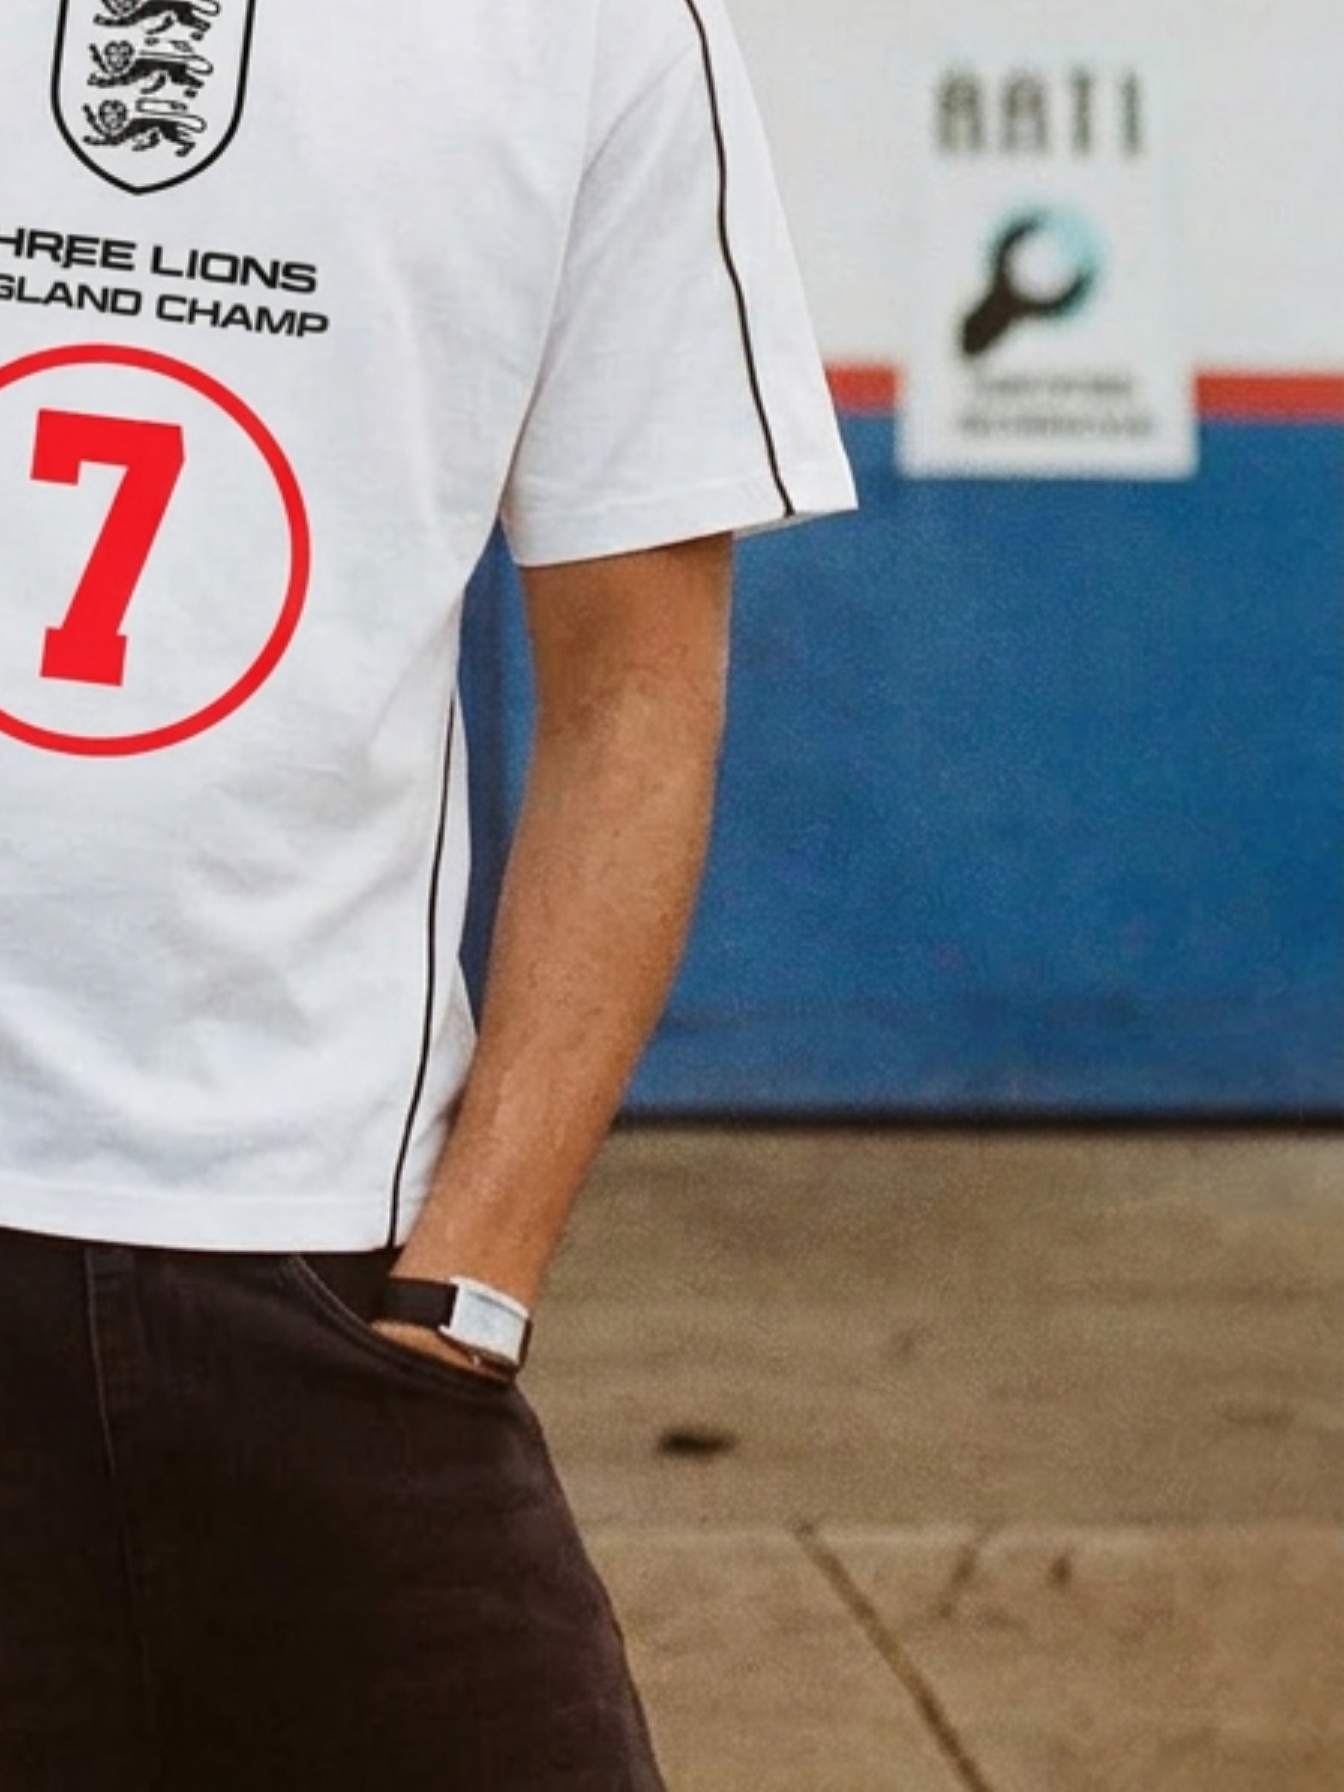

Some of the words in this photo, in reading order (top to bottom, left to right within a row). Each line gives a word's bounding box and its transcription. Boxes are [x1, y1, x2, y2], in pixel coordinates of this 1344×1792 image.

[150, 245, 318, 294] LIONS
[155, 294, 330, 338] CHAMP
[29, 407, 187, 687] 7
